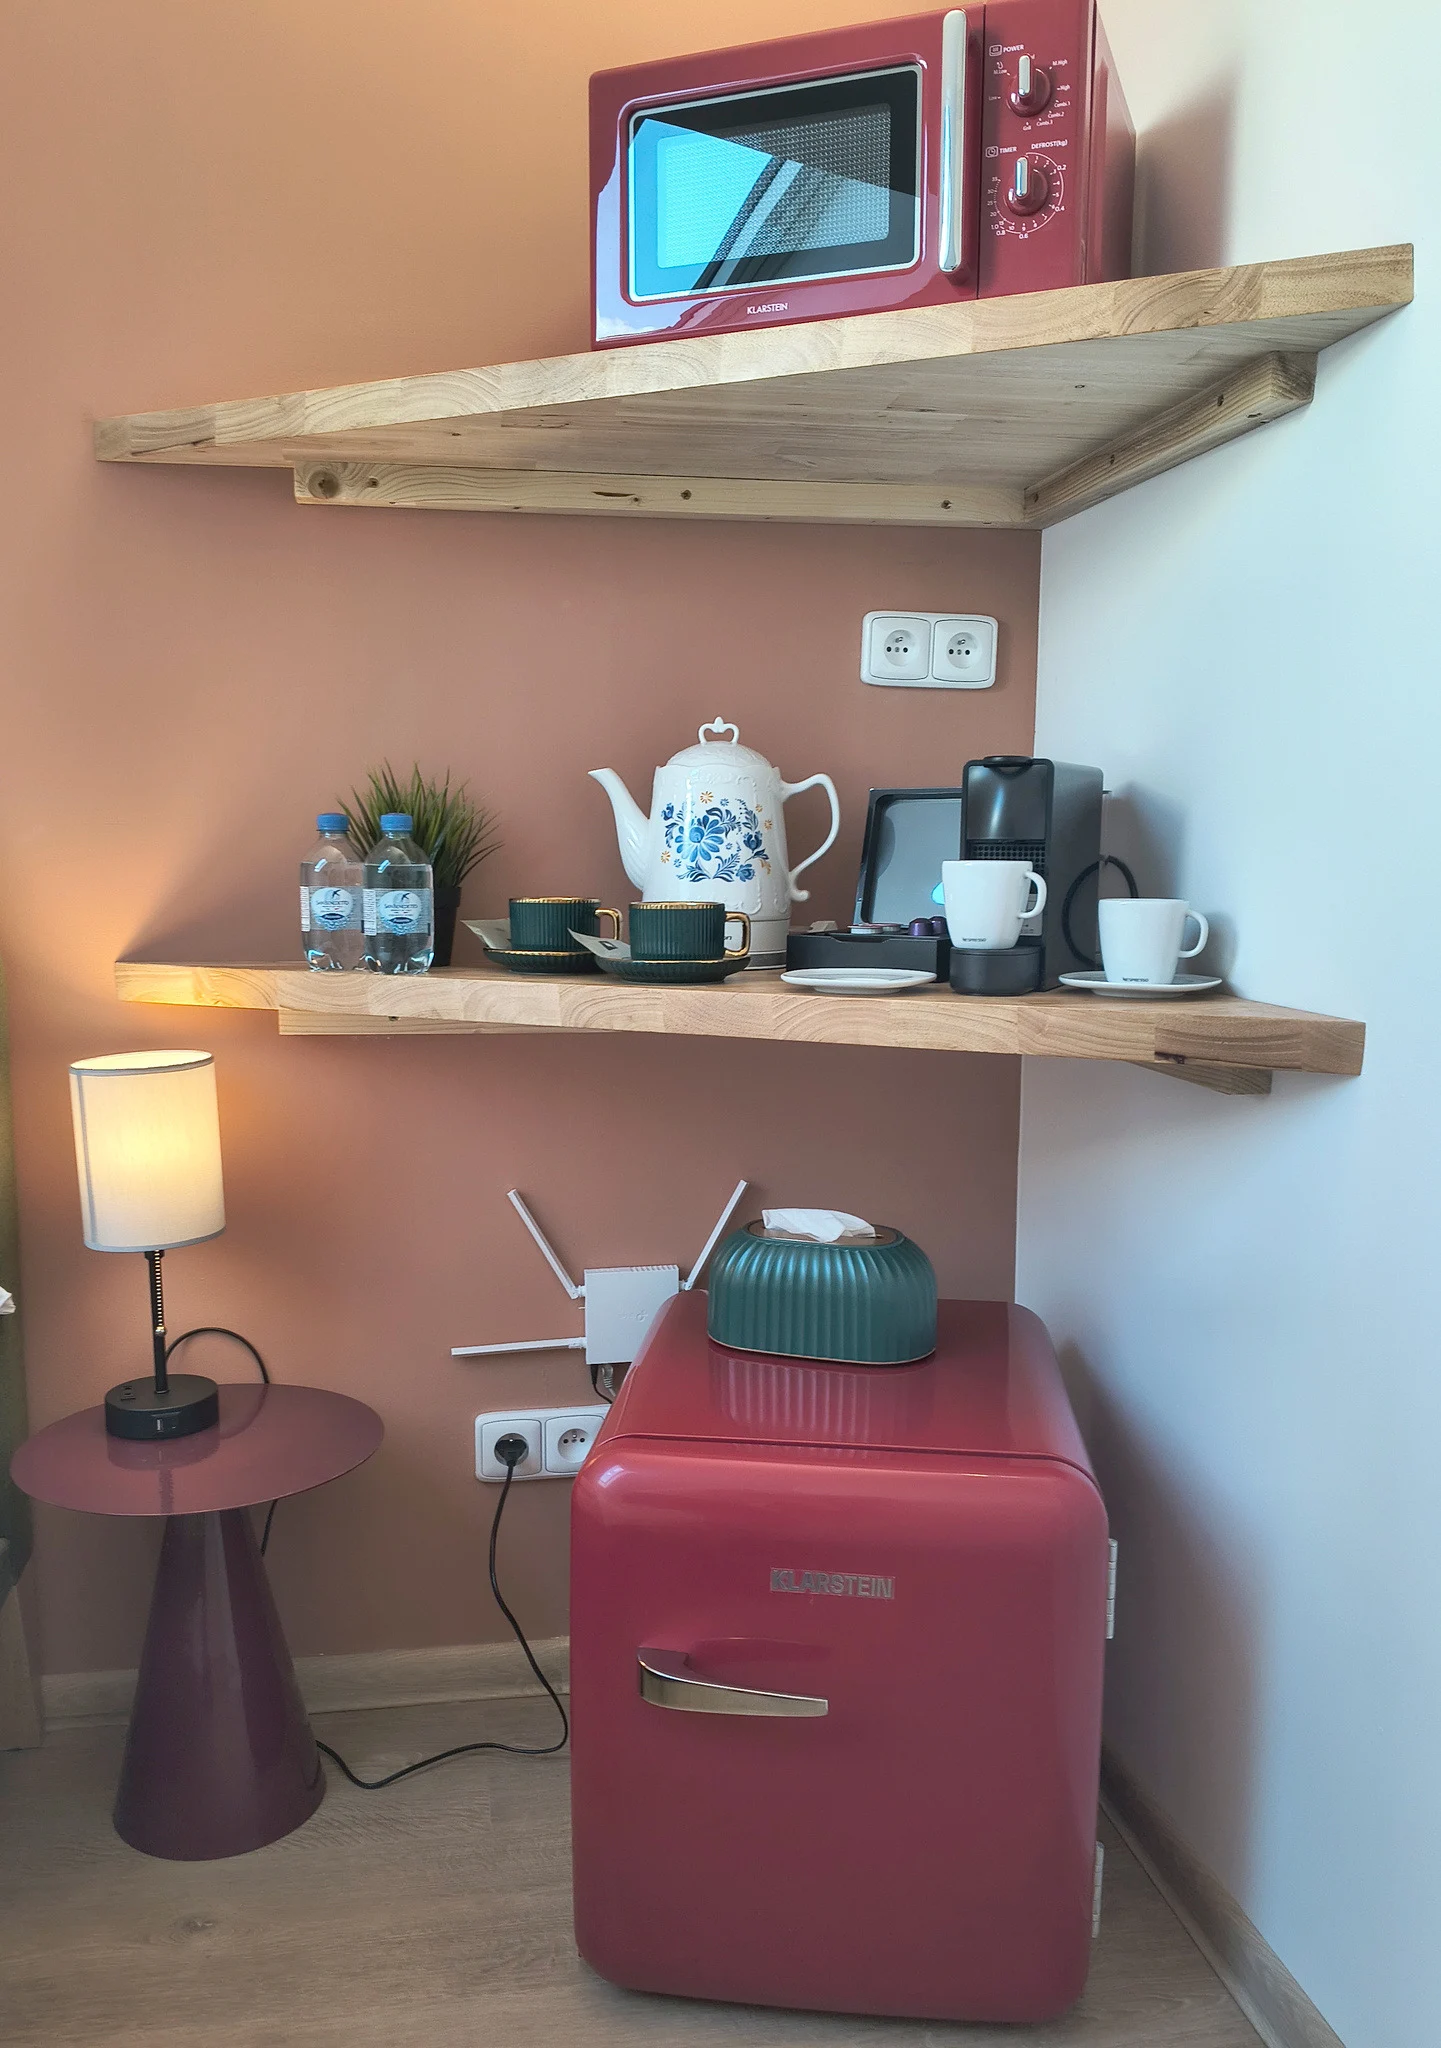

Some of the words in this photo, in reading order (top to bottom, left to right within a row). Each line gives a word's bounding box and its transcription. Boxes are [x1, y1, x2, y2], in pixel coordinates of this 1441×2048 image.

[1003, 44, 1024, 53] POWER
[999, 146, 1017, 154] TIMER
[1031, 139, 1068, 150] DEFROST(kg)
[747, 303, 788, 314] KLARSTEIN
[770, 1568, 893, 1598] KLARSTEIN
